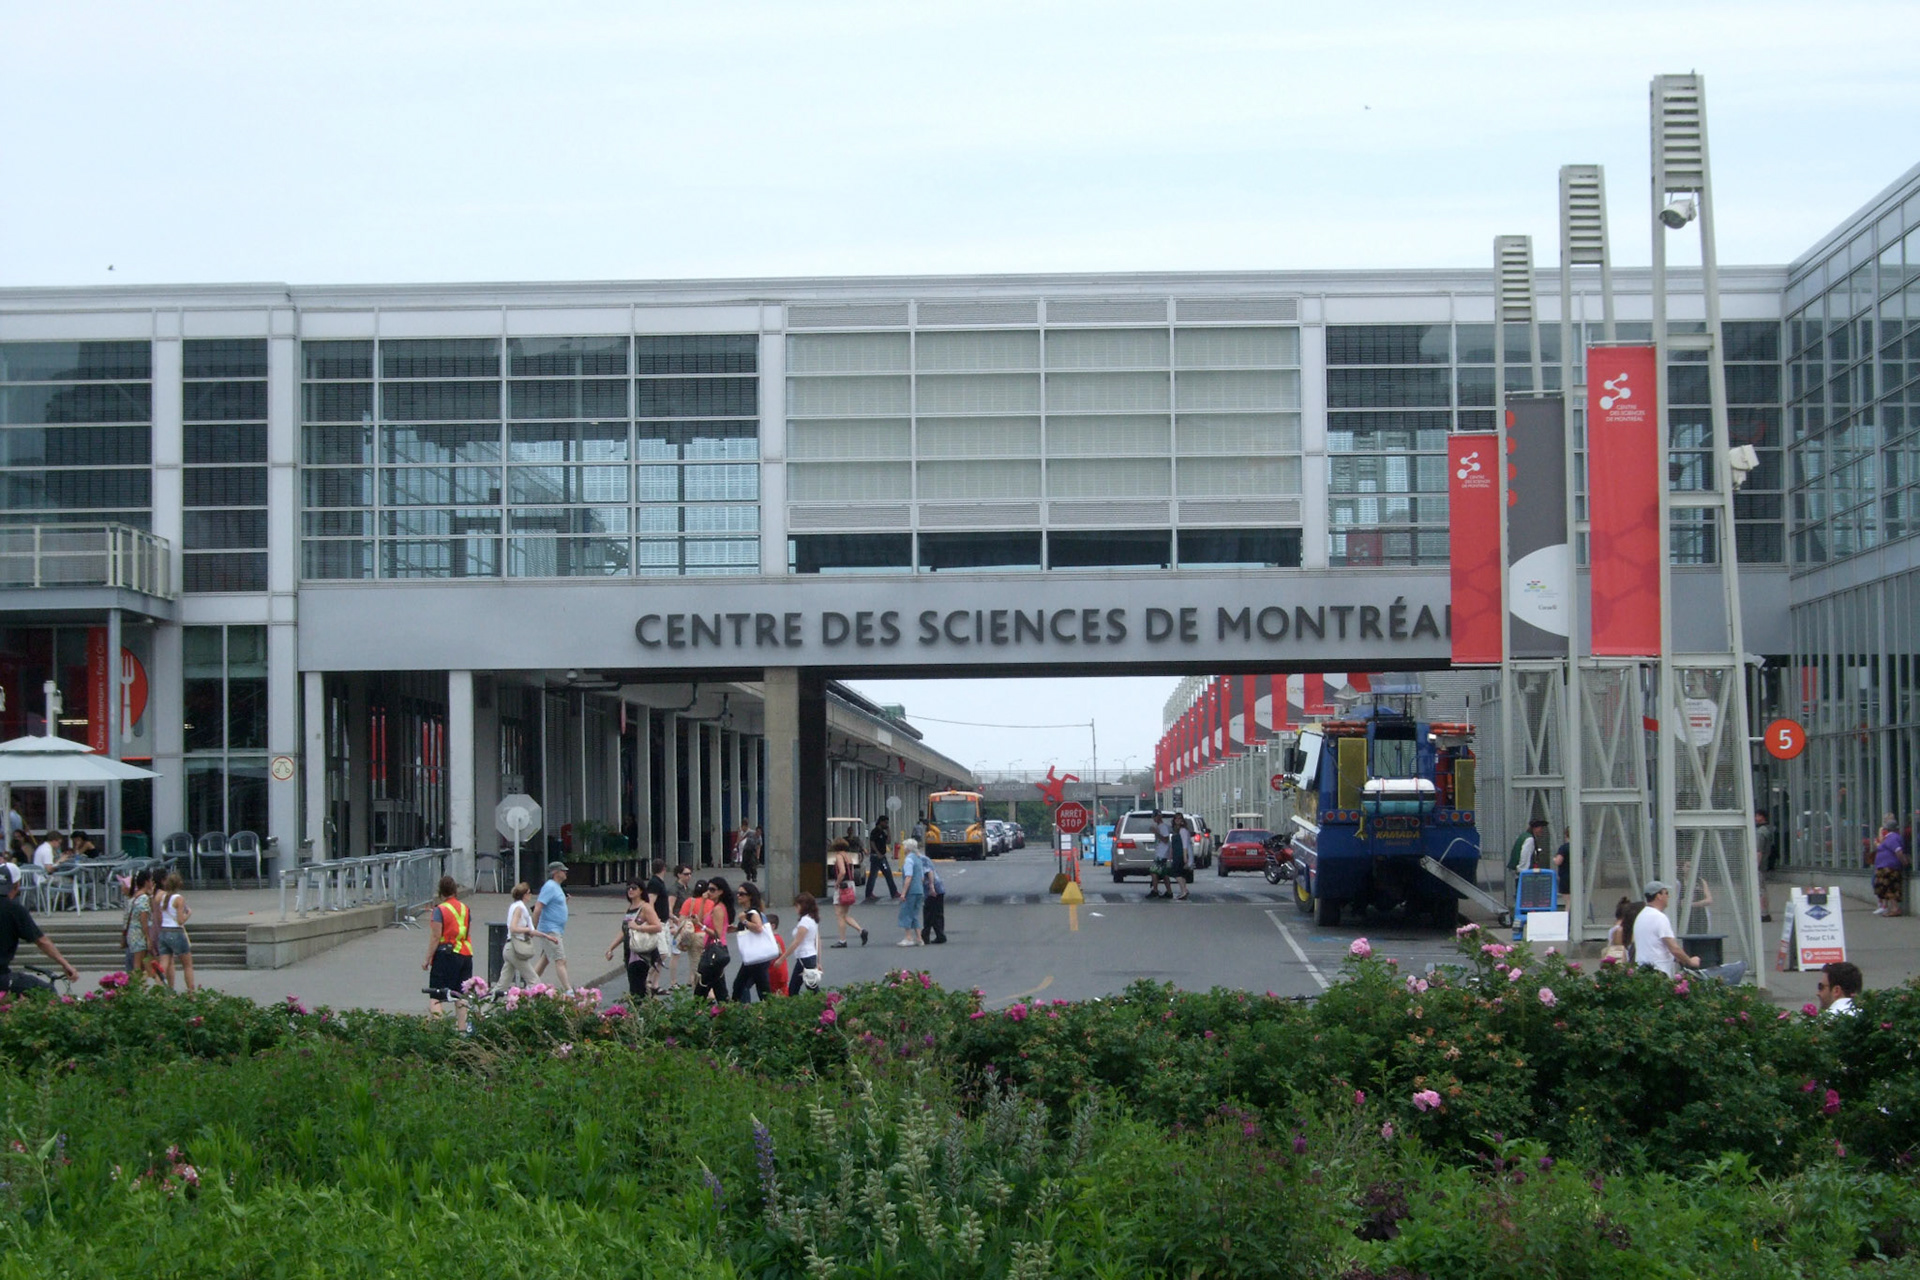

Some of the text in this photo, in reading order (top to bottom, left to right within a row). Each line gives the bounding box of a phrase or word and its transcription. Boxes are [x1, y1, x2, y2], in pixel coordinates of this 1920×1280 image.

[635, 612, 803, 647] CENTRE
[822, 611, 900, 647] DES
[919, 608, 1127, 645] SCIENCES
[1145, 607, 1198, 642] DE
[1778, 729, 1793, 750] 5
[1060, 808, 1083, 818] ARRÊT
[1061, 818, 1082, 827] STOP
